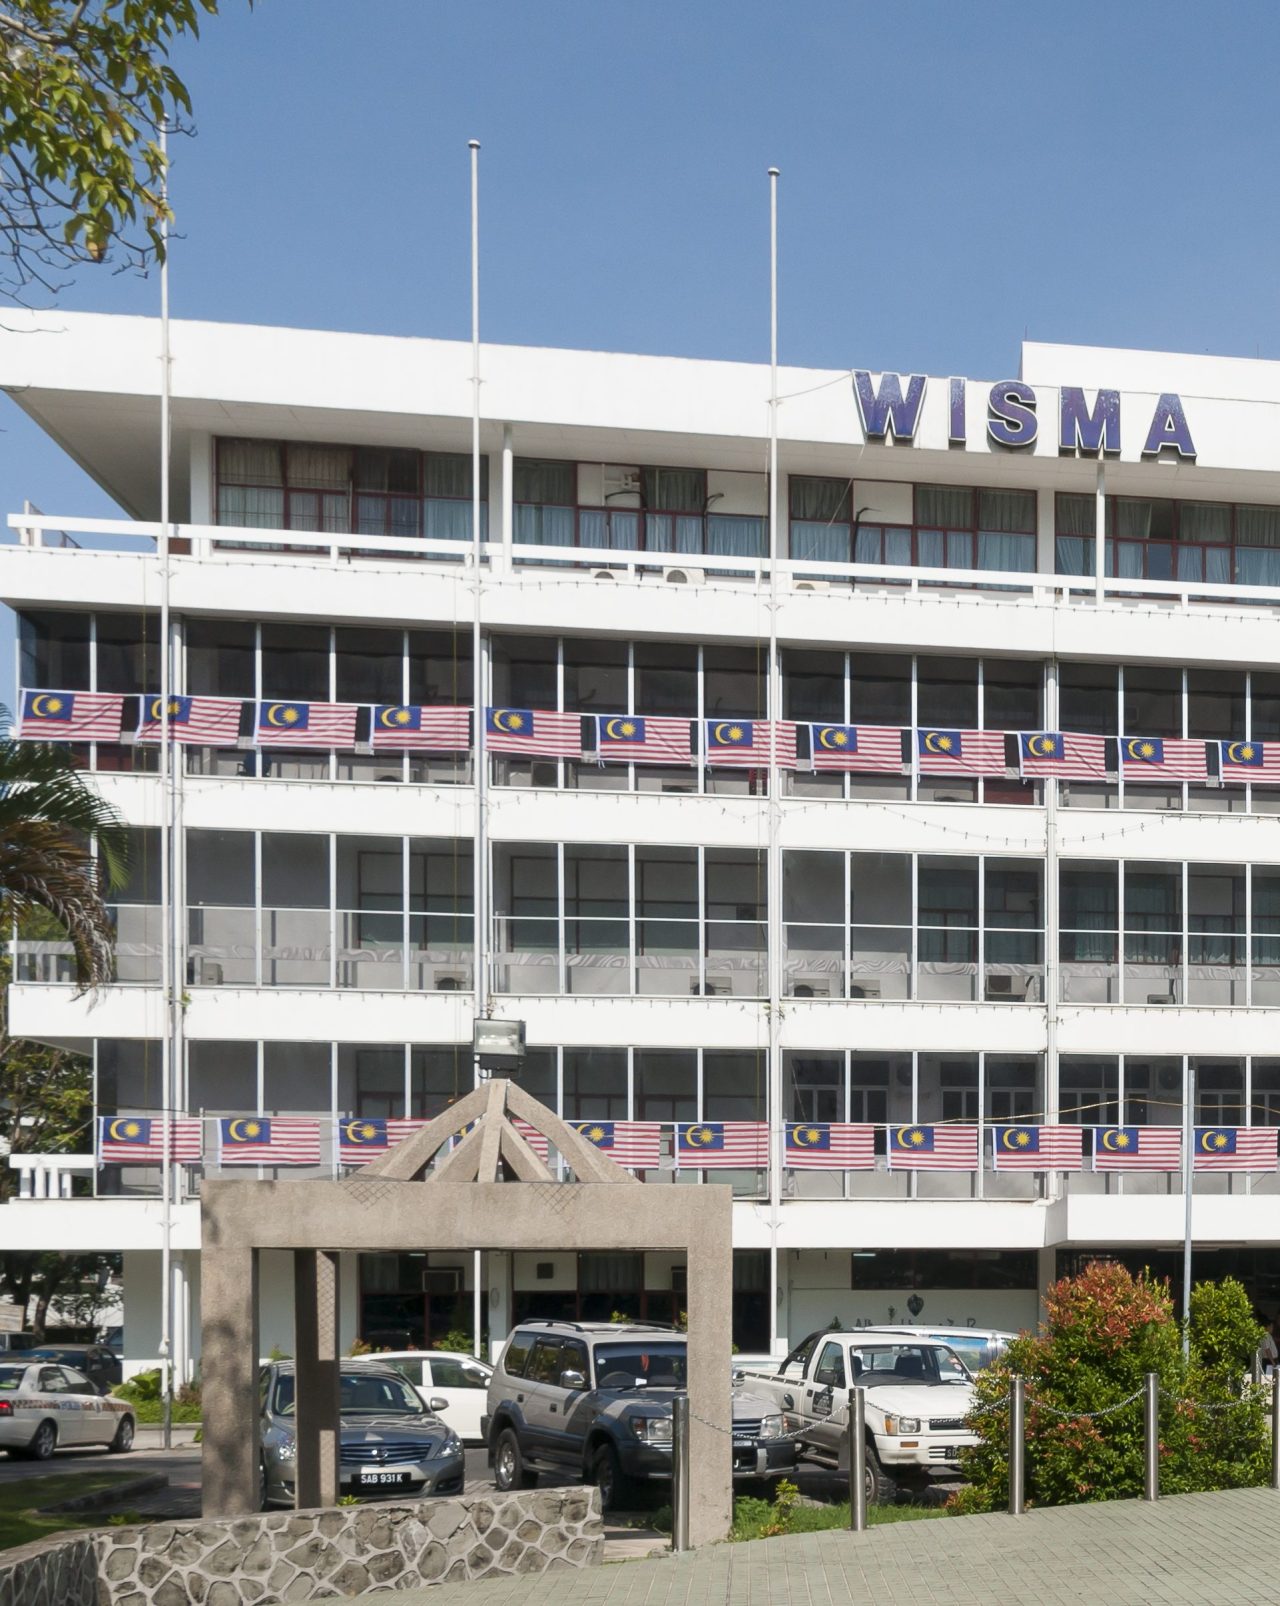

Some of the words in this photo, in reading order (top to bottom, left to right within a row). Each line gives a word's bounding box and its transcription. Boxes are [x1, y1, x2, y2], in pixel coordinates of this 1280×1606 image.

[852, 369, 1197, 464] WISMA
[361, 1474, 378, 1483] SAB
[380, 1474, 395, 1483] 931
[397, 1473, 403, 1483] K
